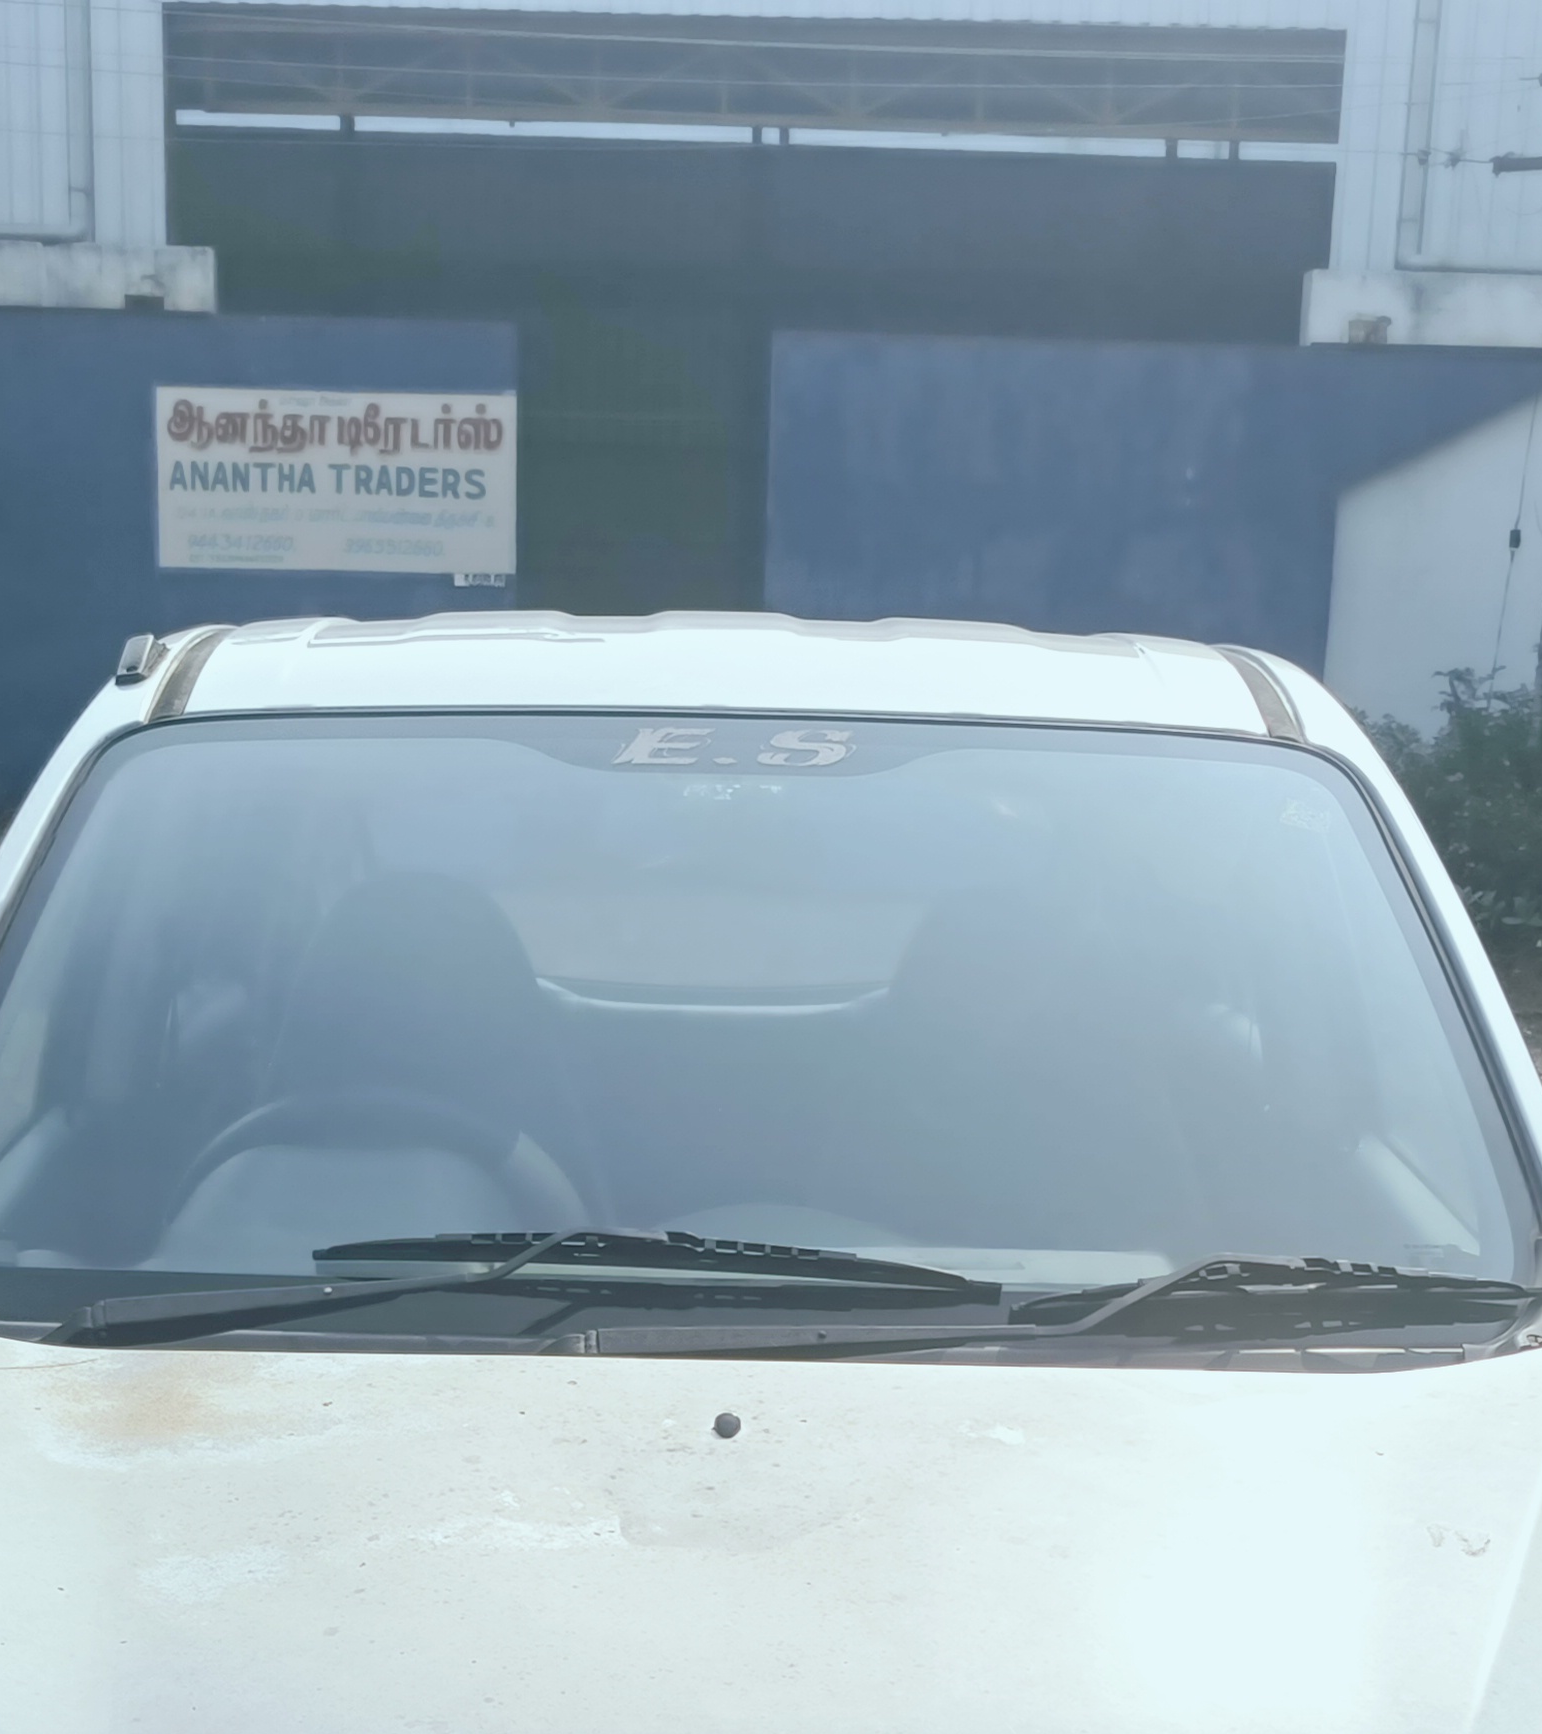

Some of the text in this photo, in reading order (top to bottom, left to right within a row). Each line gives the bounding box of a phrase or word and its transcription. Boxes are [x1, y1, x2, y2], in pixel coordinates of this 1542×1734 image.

[167, 399, 331, 453] ஆனந்தா
[169, 460, 487, 500] ANANTHA TRADERS
